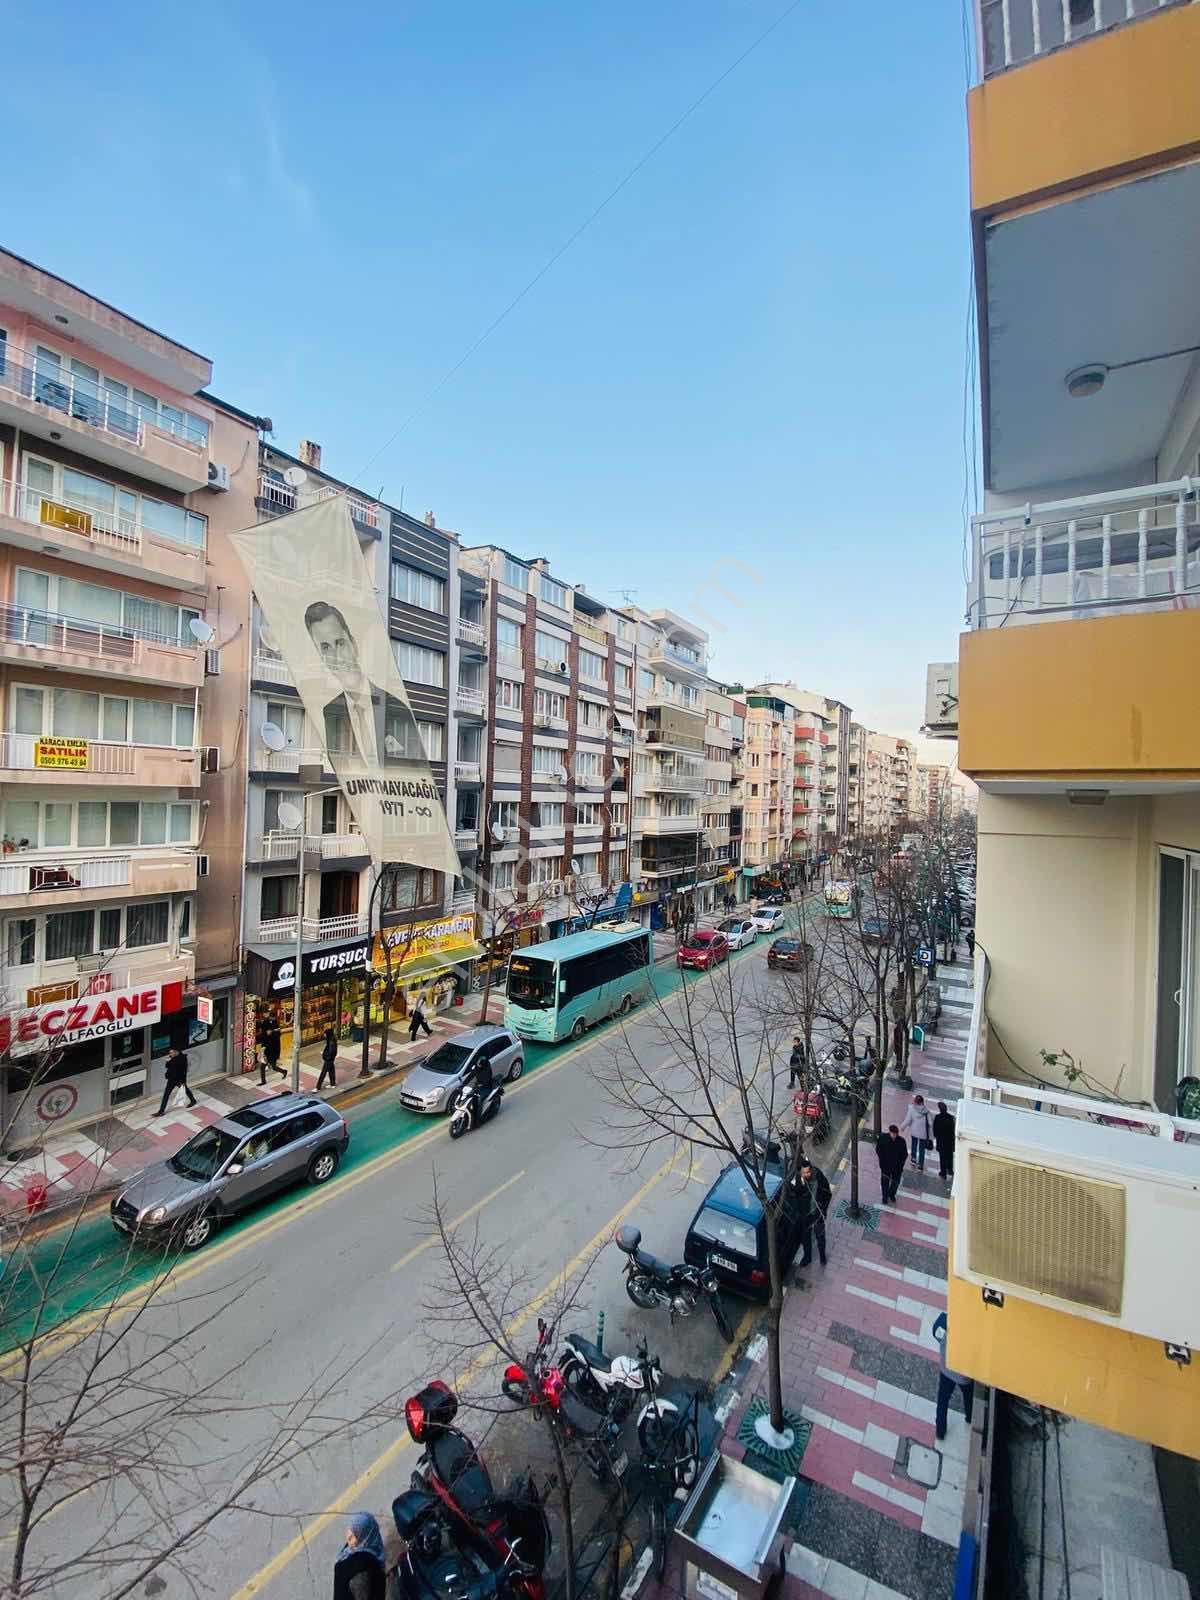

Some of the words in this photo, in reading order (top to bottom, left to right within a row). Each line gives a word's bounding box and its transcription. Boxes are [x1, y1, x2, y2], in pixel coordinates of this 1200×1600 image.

[40, 746, 88, 757] SATILIK
[380, 799, 404, 817] 1977
[16, 989, 158, 1042] ECZANE
